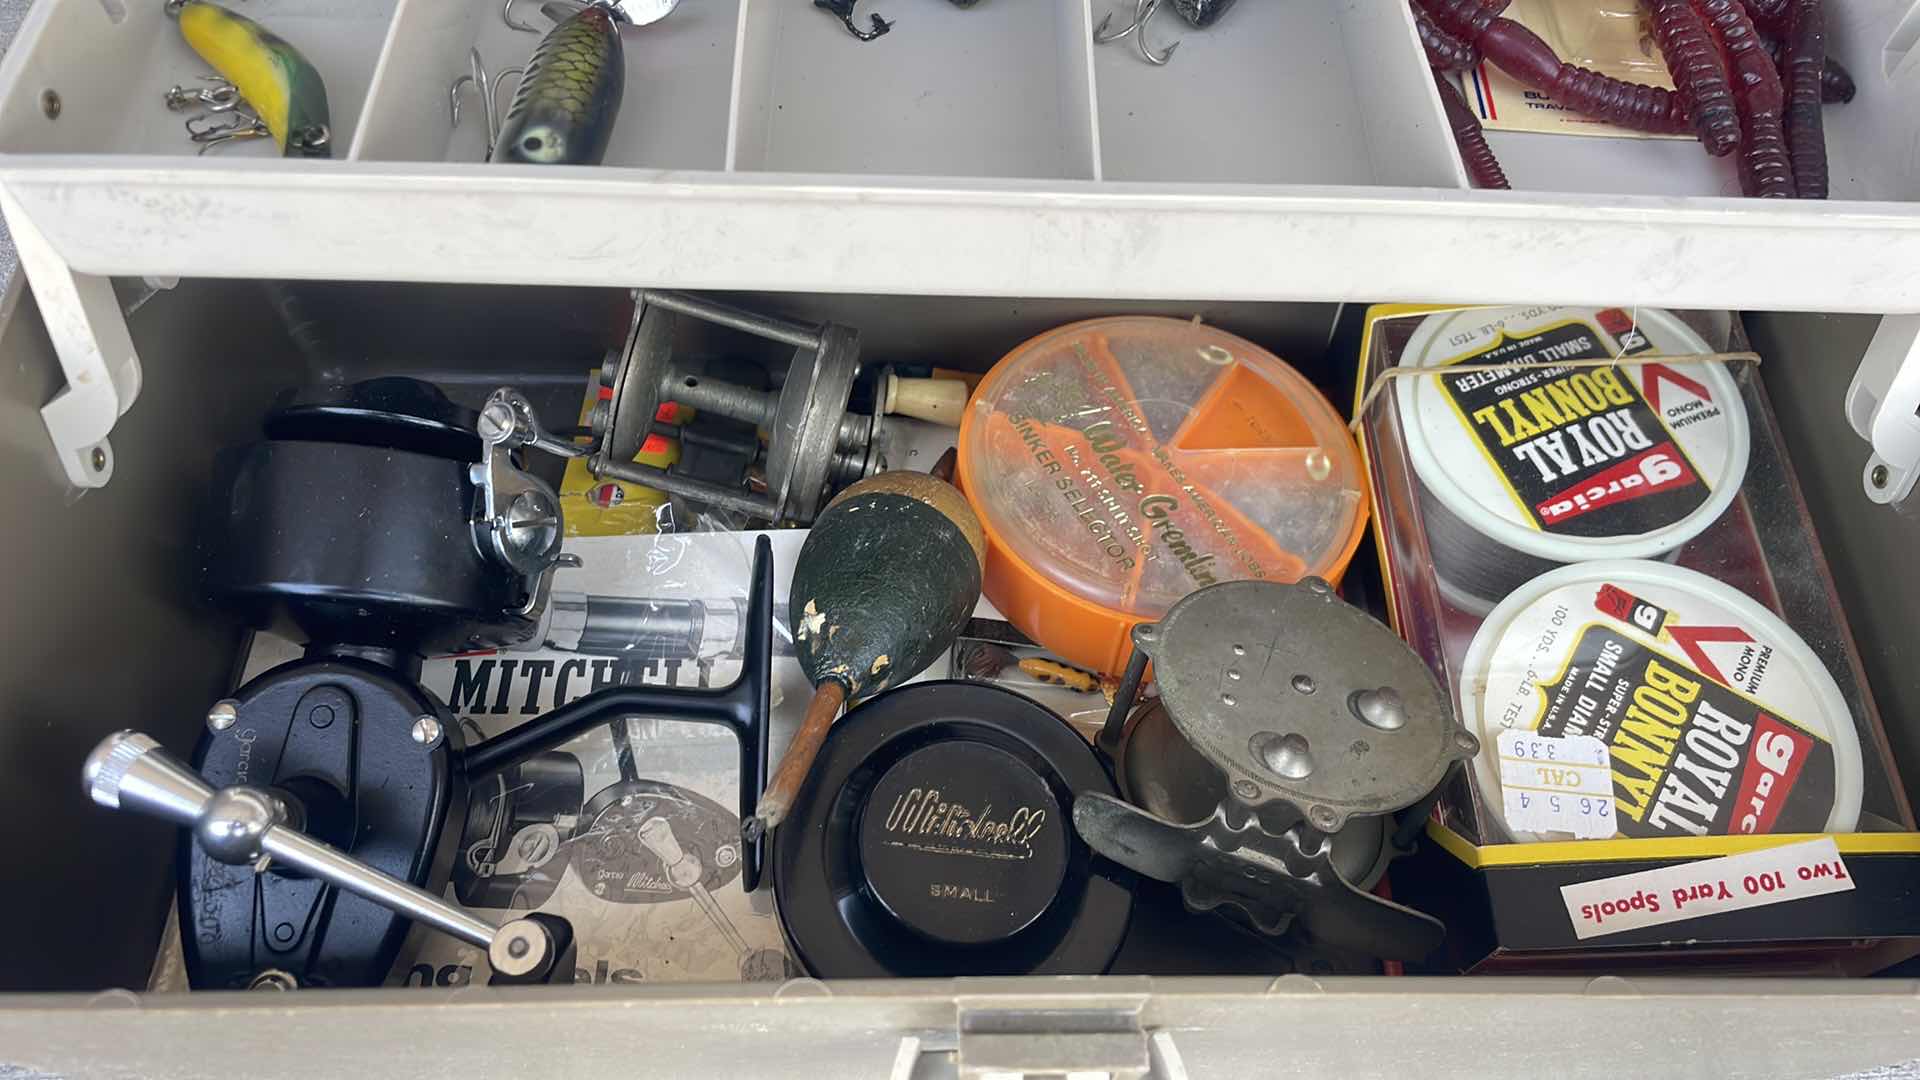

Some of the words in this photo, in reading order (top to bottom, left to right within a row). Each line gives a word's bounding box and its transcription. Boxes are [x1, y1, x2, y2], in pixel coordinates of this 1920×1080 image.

[1525, 102, 1576, 112] TRAV
[1449, 330, 1478, 347] TEST
[1538, 336, 1593, 361] SMALL
[1473, 366, 1635, 448] BONNYL
[1666, 399, 1705, 418] MONO
[1669, 407, 1721, 431] PREMIUM
[1008, 413, 1062, 475] SINKER
[1083, 420, 1144, 494] Water
[1513, 408, 1654, 484] ROYAL
[1548, 453, 1683, 517] garcia
[1551, 605, 1569, 627] 100
[1585, 640, 1624, 692] SMALL
[1733, 645, 1756, 682] MONO
[1746, 645, 1773, 696] PREMIUM
[1561, 666, 1580, 694] MADE
[1553, 693, 1567, 707] IN
[1592, 678, 1630, 739] SUPER-STR
[1514, 741, 1556, 760] 3.39
[1536, 767, 1583, 788] CAL
[1648, 700, 1752, 836] ROYAL
[1741, 731, 1795, 834] garc
[1743, 871, 1786, 895] 100
[1797, 860, 1848, 881] Two
[930, 884, 995, 903] SMALL
[1581, 892, 1659, 923] Spools
[1672, 880, 1734, 909] Yard
